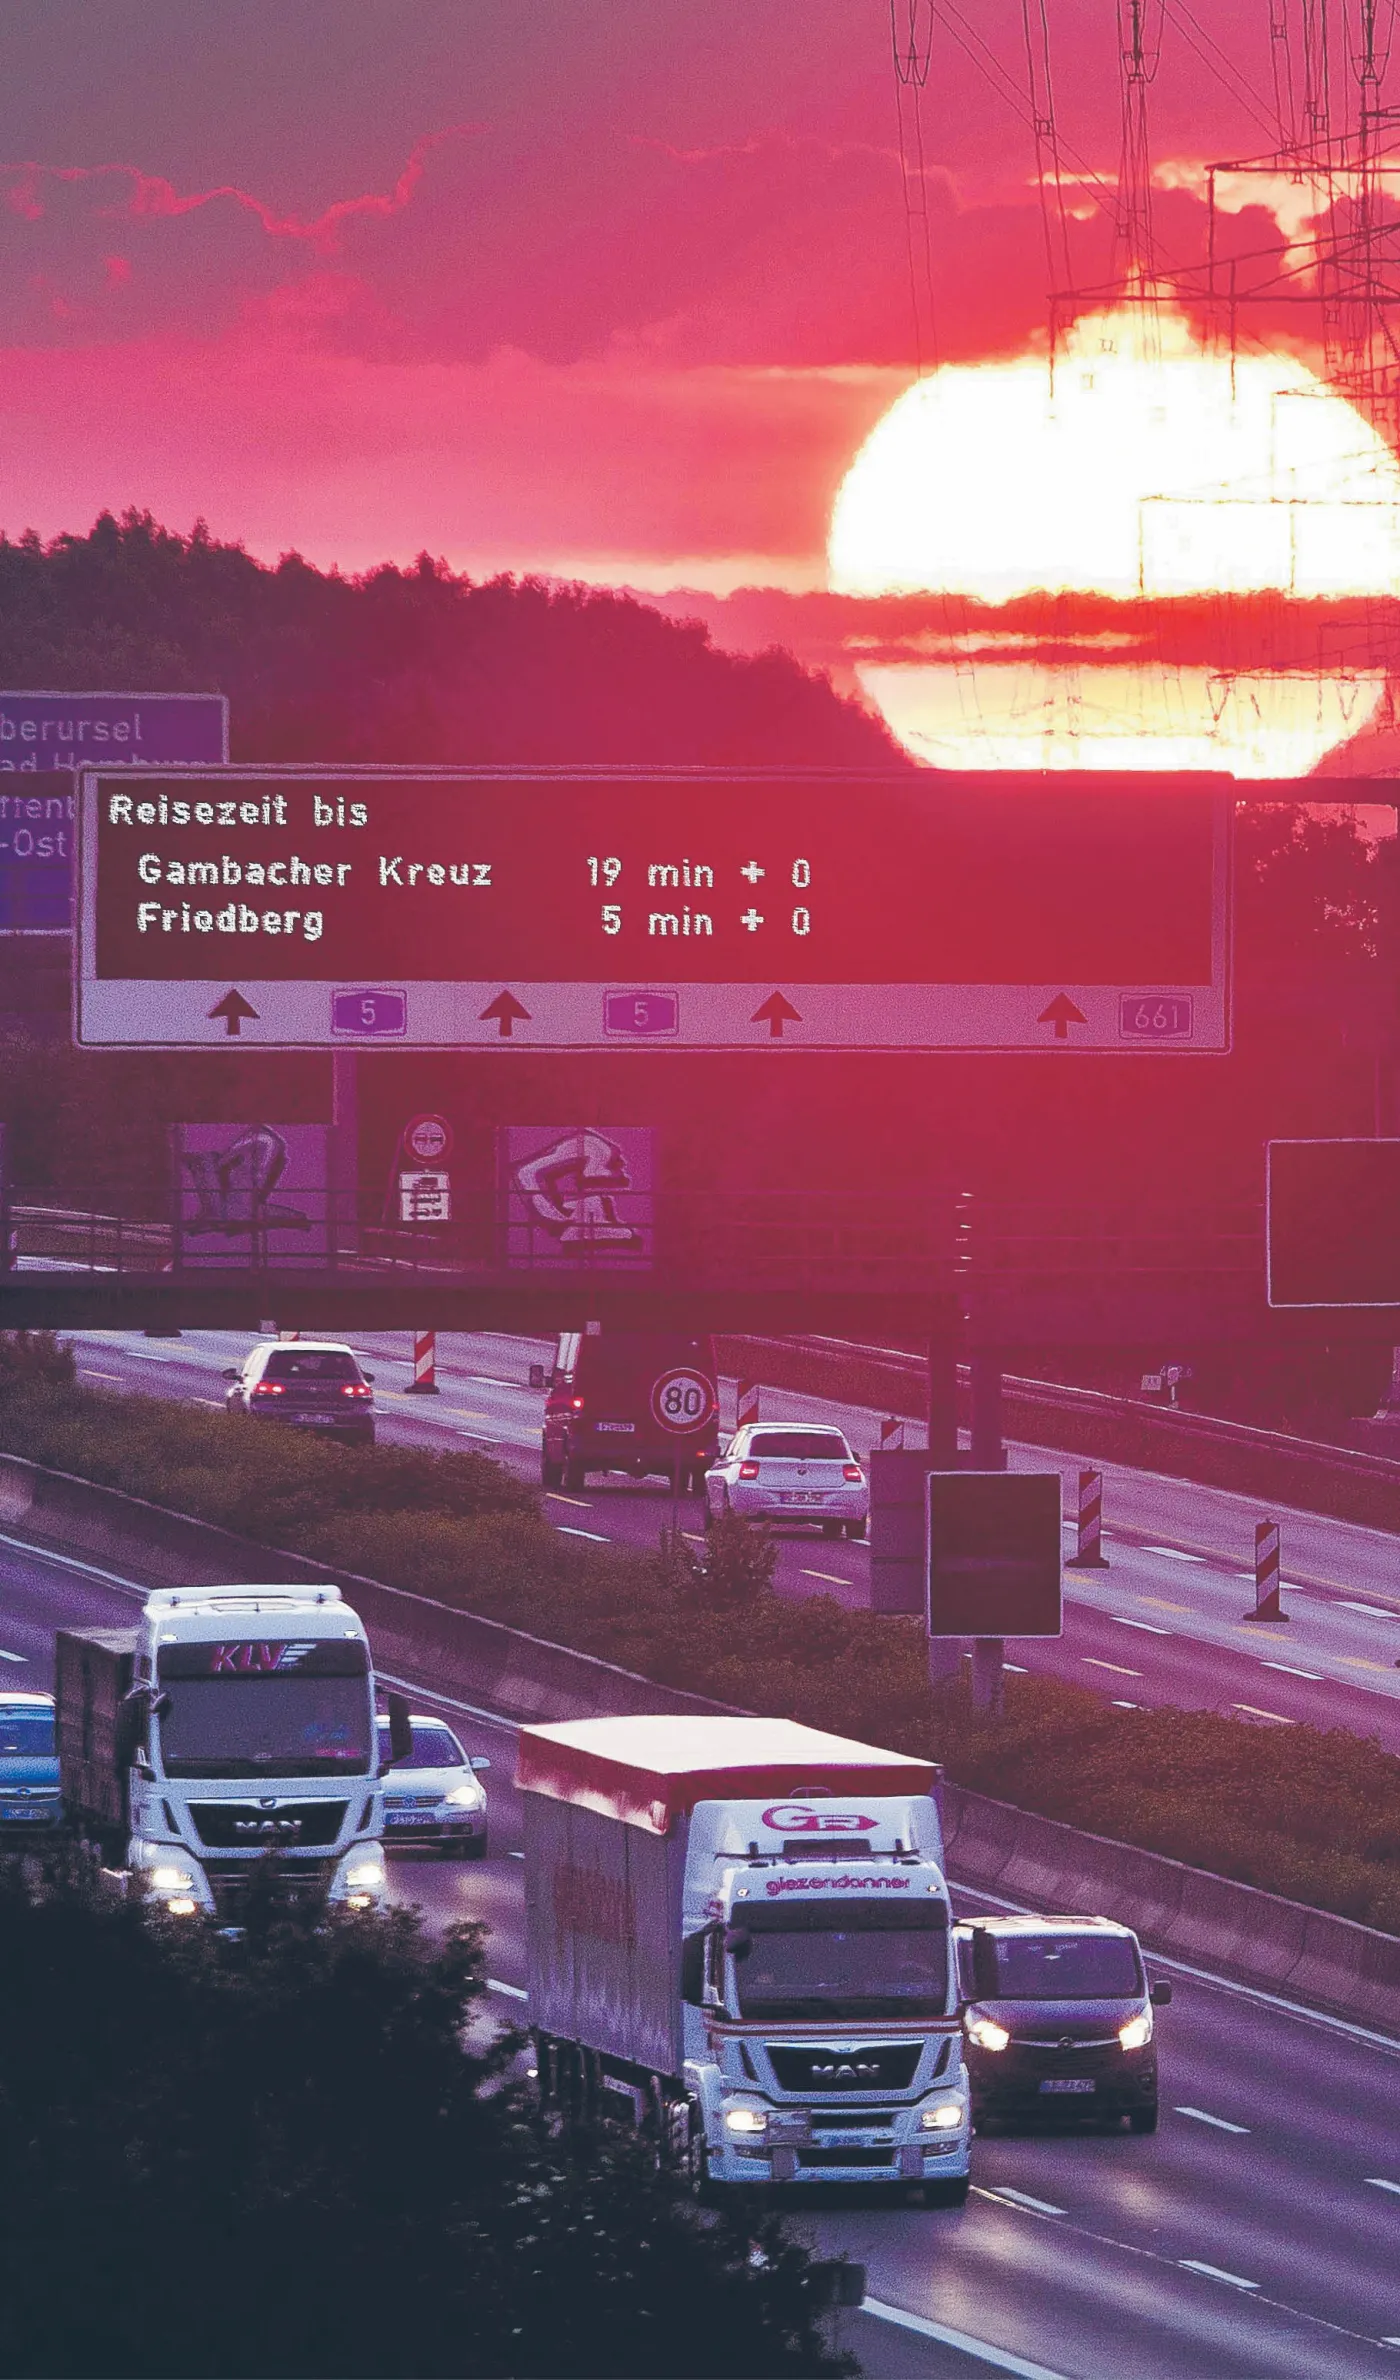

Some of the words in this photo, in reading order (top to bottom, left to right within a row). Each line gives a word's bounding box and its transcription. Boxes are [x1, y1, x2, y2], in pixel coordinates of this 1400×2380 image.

[108, 793, 288, 826] Reisezeit
[313, 795, 368, 827] bis
[137, 852, 352, 887] Gambacher
[379, 856, 492, 886] Kreuz
[587, 856, 622, 887] 19
[647, 858, 714, 888] min
[740, 861, 765, 884] +
[791, 858, 811, 888] 0
[136, 901, 323, 942] Friedberg
[601, 904, 622, 935] 5
[648, 905, 713, 936] min
[741, 908, 764, 932] +
[792, 907, 811, 936] 0
[361, 1000, 377, 1025] 5
[633, 1001, 649, 1027] 5
[1135, 1003, 1178, 1029] 661
[665, 1386, 701, 1416] 80
[211, 1644, 288, 1673] KLV
[234, 1820, 302, 1834] MAN
[811, 2063, 880, 2079] MAN
